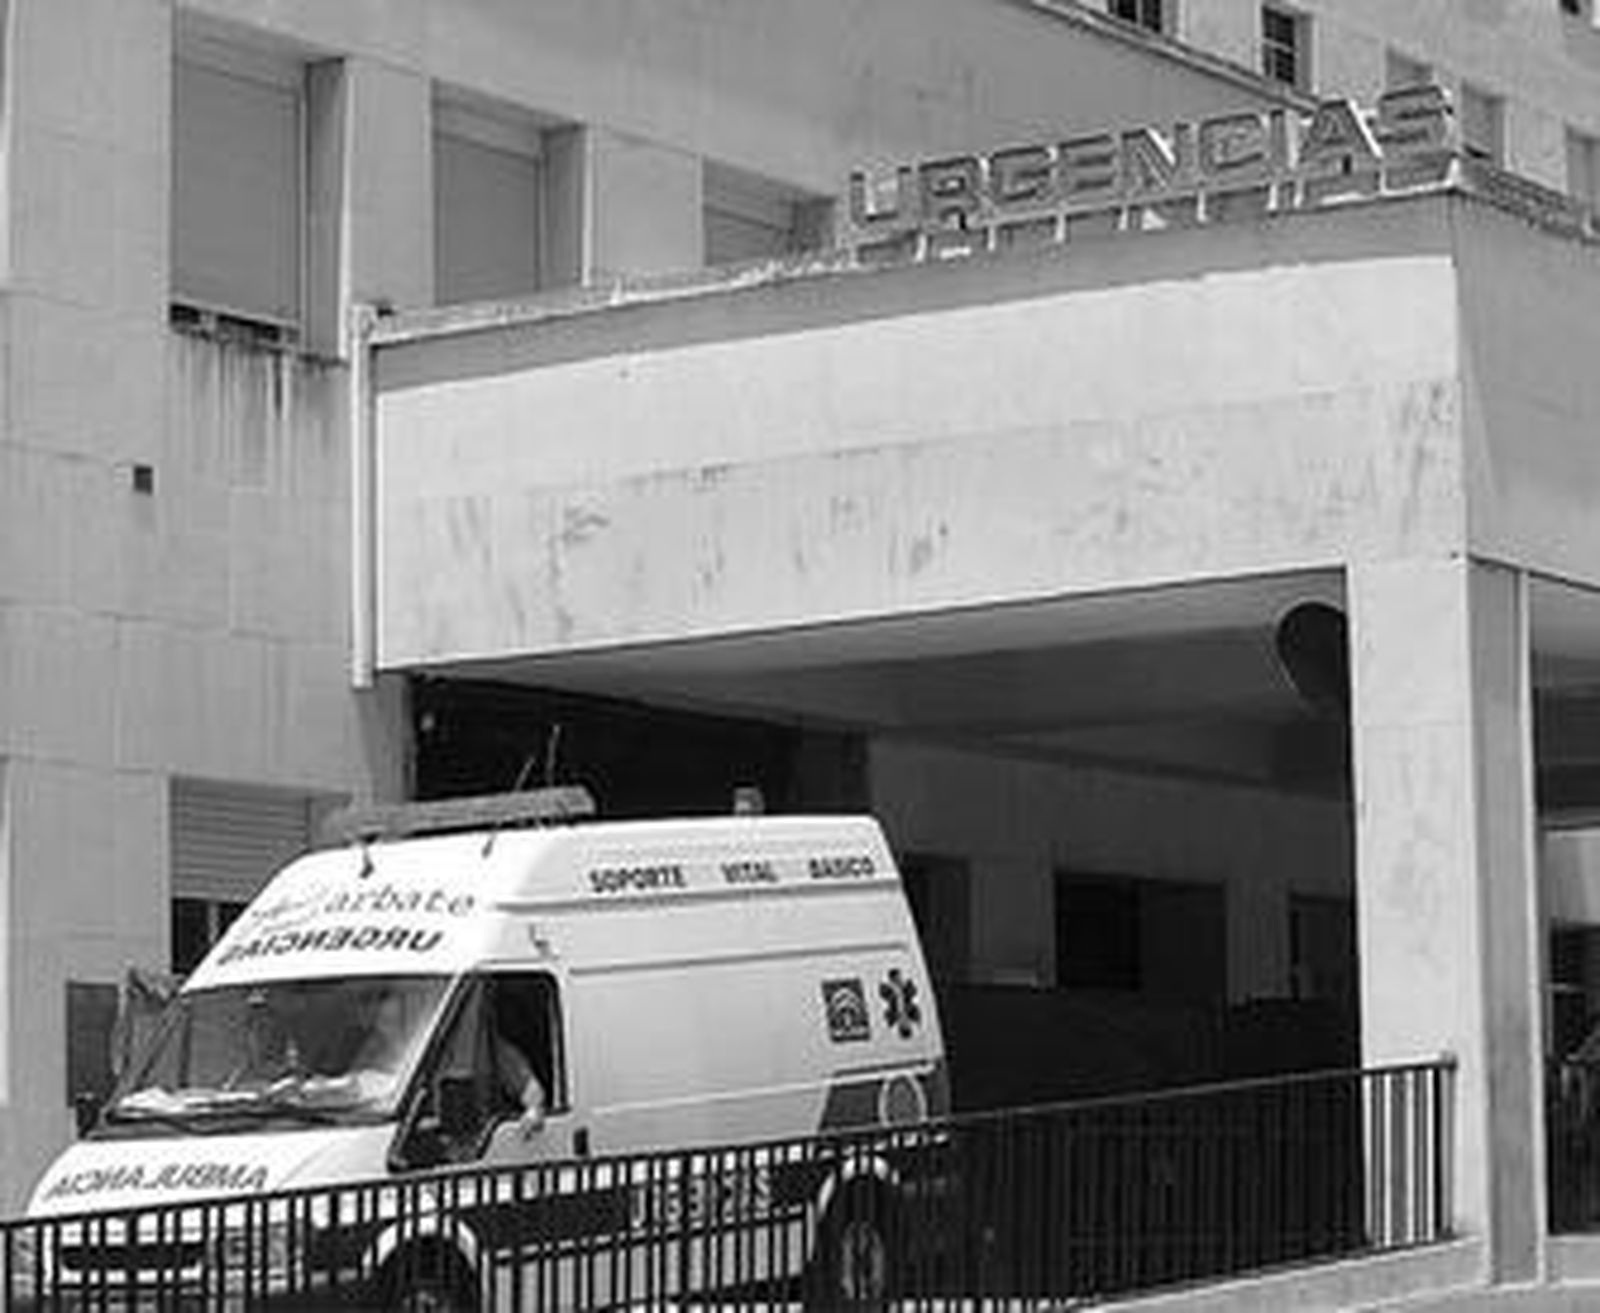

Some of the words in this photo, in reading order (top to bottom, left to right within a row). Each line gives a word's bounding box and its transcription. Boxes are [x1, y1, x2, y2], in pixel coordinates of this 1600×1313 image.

[849, 83, 1455, 230] URGENCIAS
[590, 865, 687, 893] SOPORTE
[720, 860, 778, 883] VITAL
